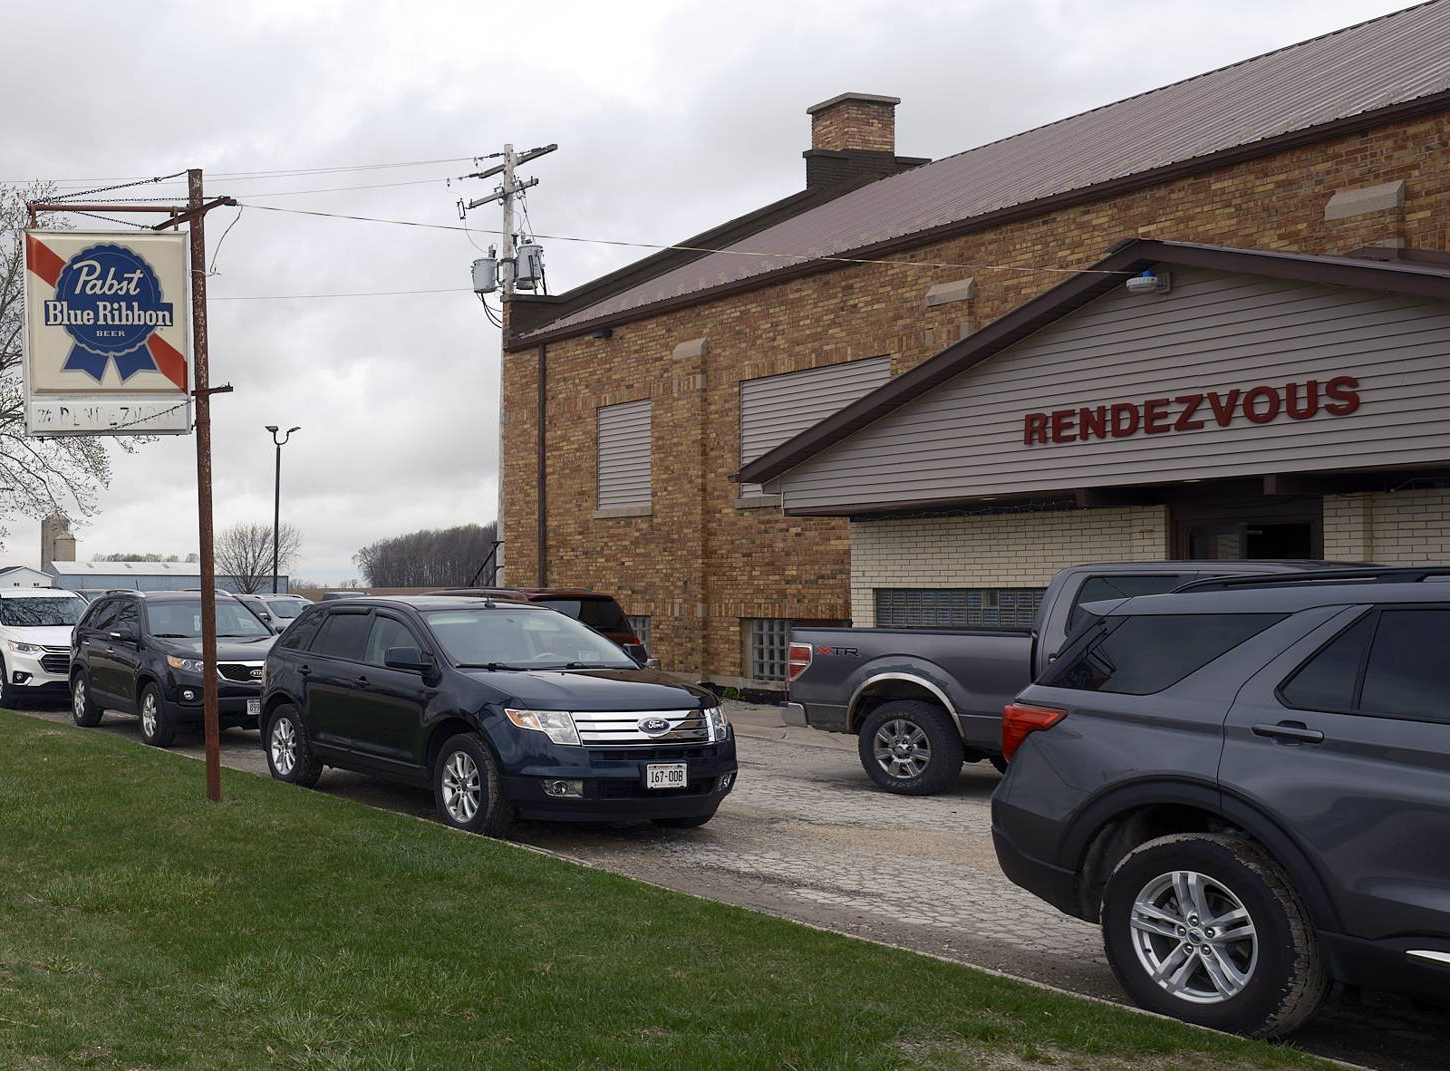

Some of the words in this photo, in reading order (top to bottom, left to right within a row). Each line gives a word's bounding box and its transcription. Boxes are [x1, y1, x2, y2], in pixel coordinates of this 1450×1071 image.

[73, 260, 144, 295] Pabst
[47, 301, 94, 325] Blue
[97, 301, 173, 326] Ribbon
[1023, 376, 1361, 446] RENDEZVOUS
[817, 646, 861, 656] XTR
[648, 720, 665, 729] Ford
